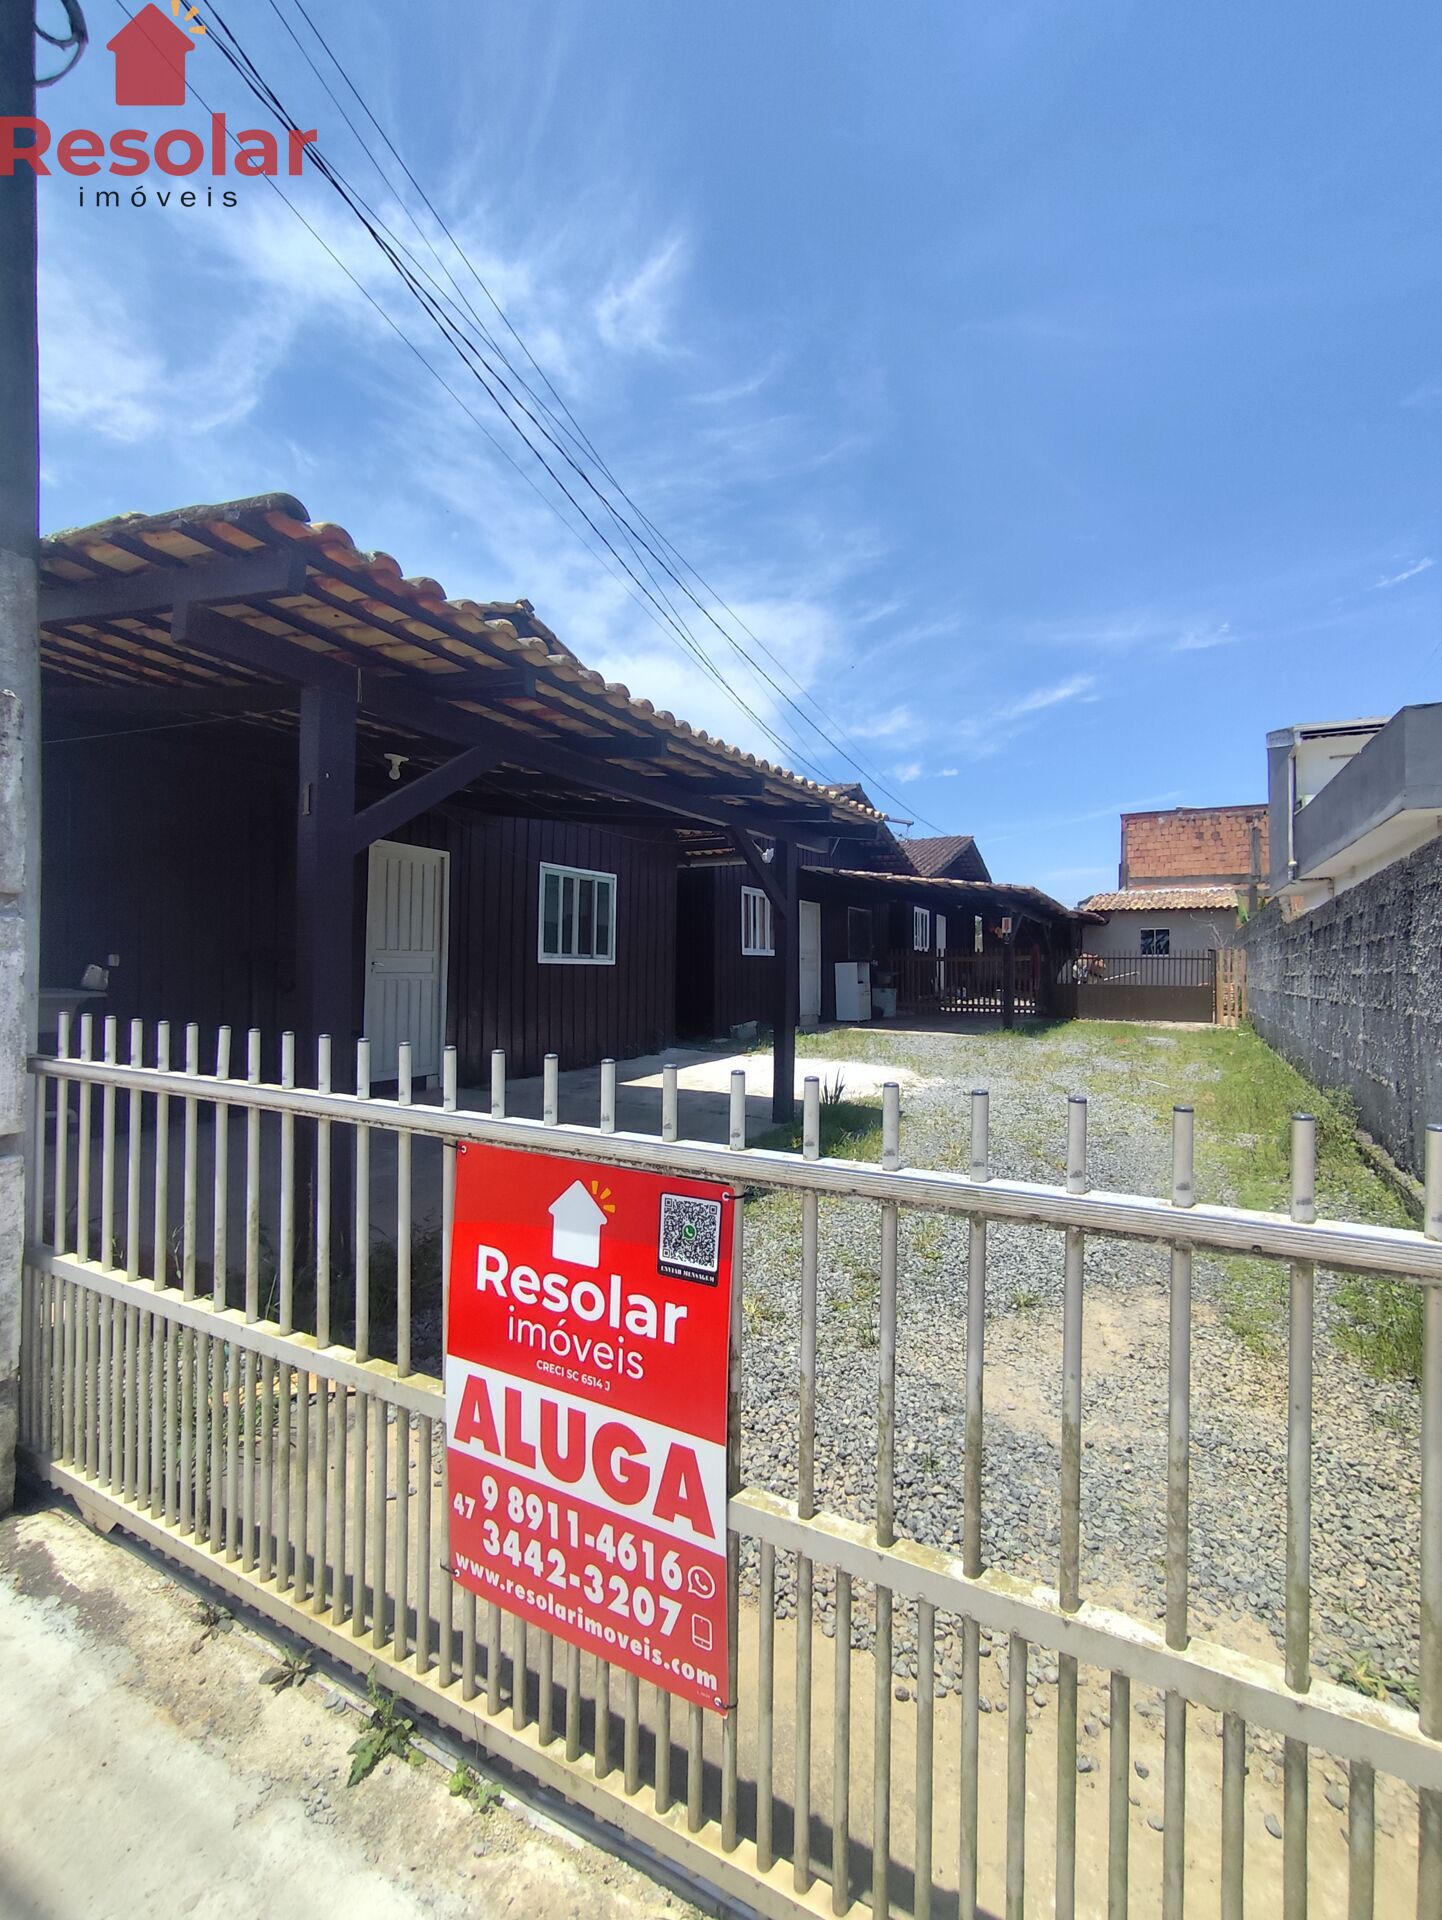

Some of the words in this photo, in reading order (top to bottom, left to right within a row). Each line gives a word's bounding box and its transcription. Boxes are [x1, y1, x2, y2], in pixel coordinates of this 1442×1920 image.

[476, 1243, 688, 1345] Resolar
[507, 1304, 645, 1380] imóveis
[536, 1359, 565, 1377] CRECI
[566, 1368, 580, 1381] SC
[581, 1373, 604, 1390] 6514
[604, 1380, 611, 1392] J
[453, 1373, 716, 1540] ALUGA
[453, 1492, 476, 1519] 47
[481, 1475, 499, 1512] 9
[507, 1486, 683, 1591] 8911-4616
[482, 1519, 682, 1636] 3442-3207
[455, 1551, 717, 1691] www.resolarimoveis.com
